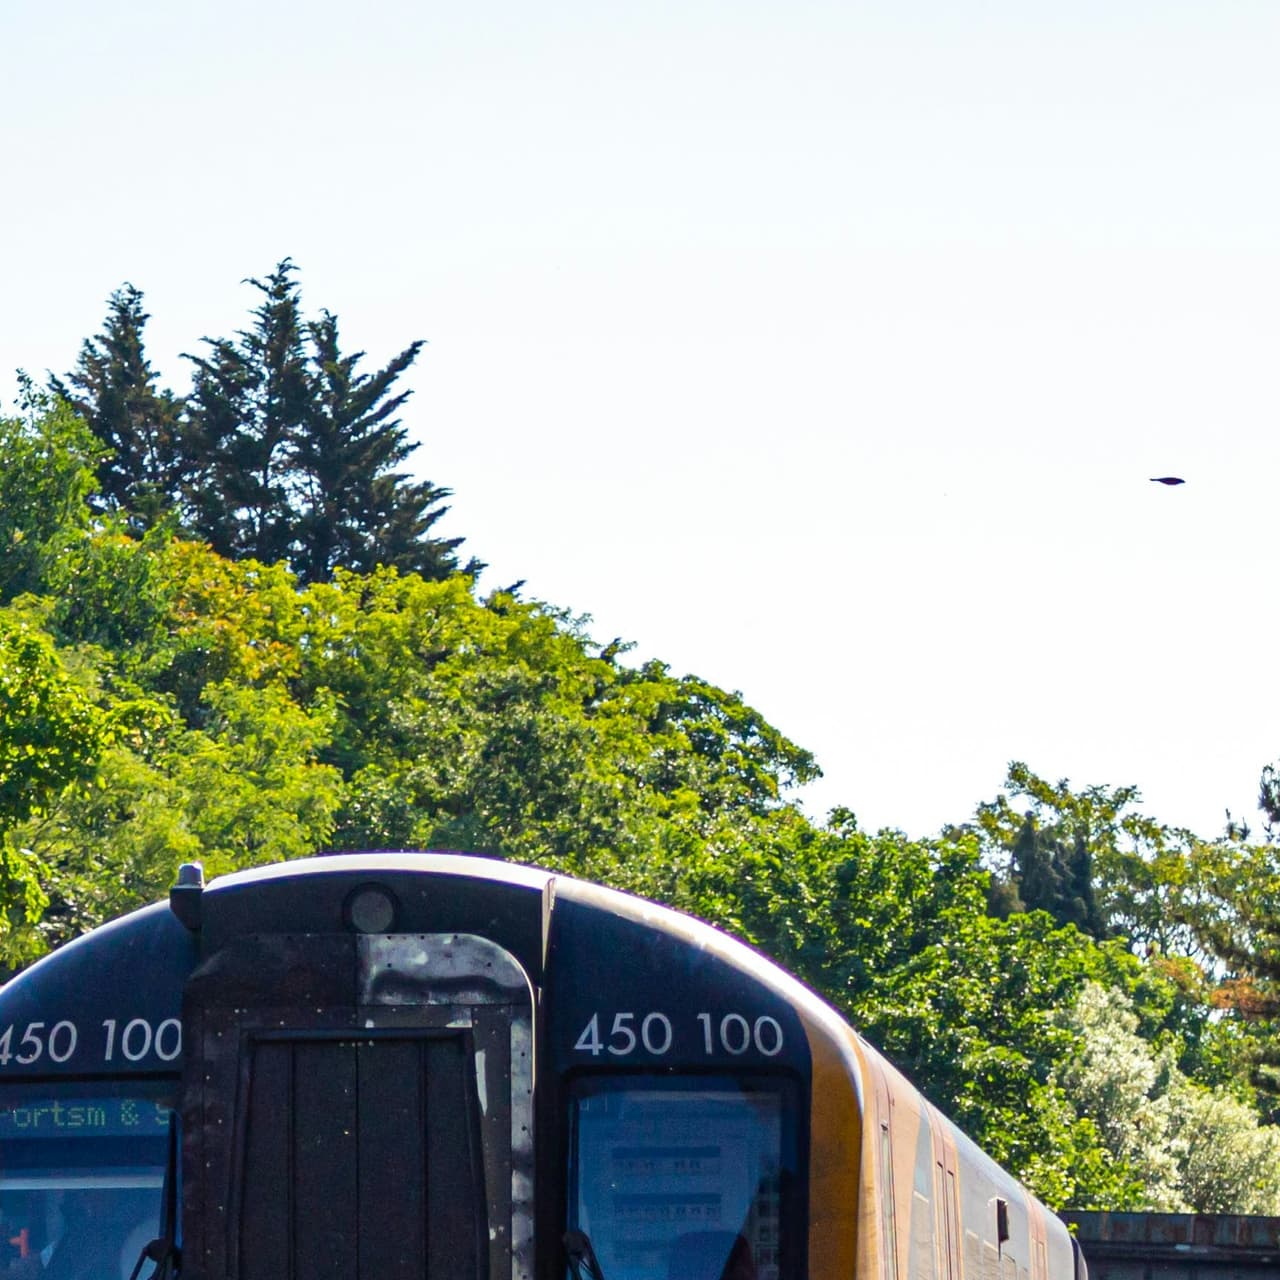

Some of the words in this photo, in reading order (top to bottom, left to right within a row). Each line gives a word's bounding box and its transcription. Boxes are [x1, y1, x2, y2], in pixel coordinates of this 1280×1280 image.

[102, 1018, 182, 1062] 100
[574, 1012, 673, 1056] 450
[697, 1013, 784, 1057] 100
[121, 1099, 139, 1126] &
